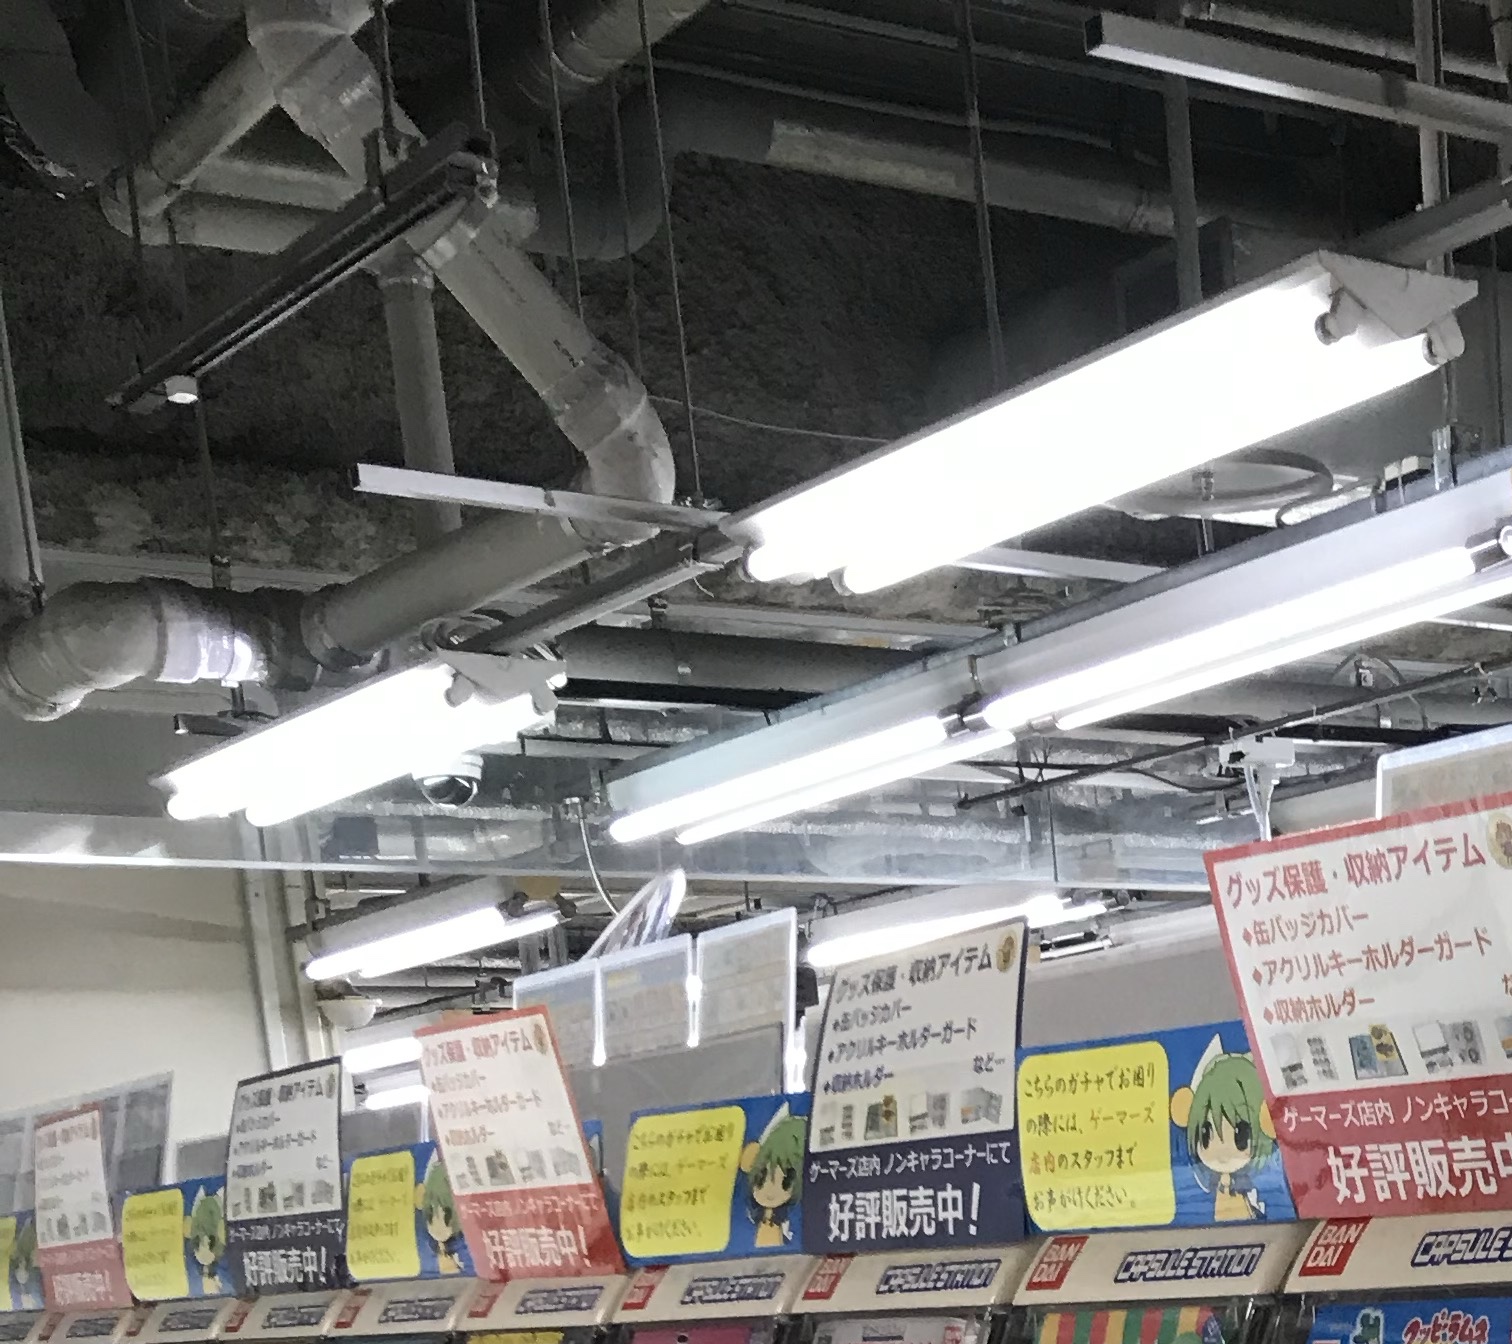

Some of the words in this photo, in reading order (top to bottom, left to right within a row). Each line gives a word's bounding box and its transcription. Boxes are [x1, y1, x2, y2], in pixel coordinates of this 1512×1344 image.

[1227, 833, 1487, 909] グッズ保護・収納アイテム
[1253, 905, 1369, 944] 缶バッジカバー
[1274, 990, 1376, 1025] 収納ホルダー
[1282, 1095, 1395, 1132] ゲーマーズ店内
